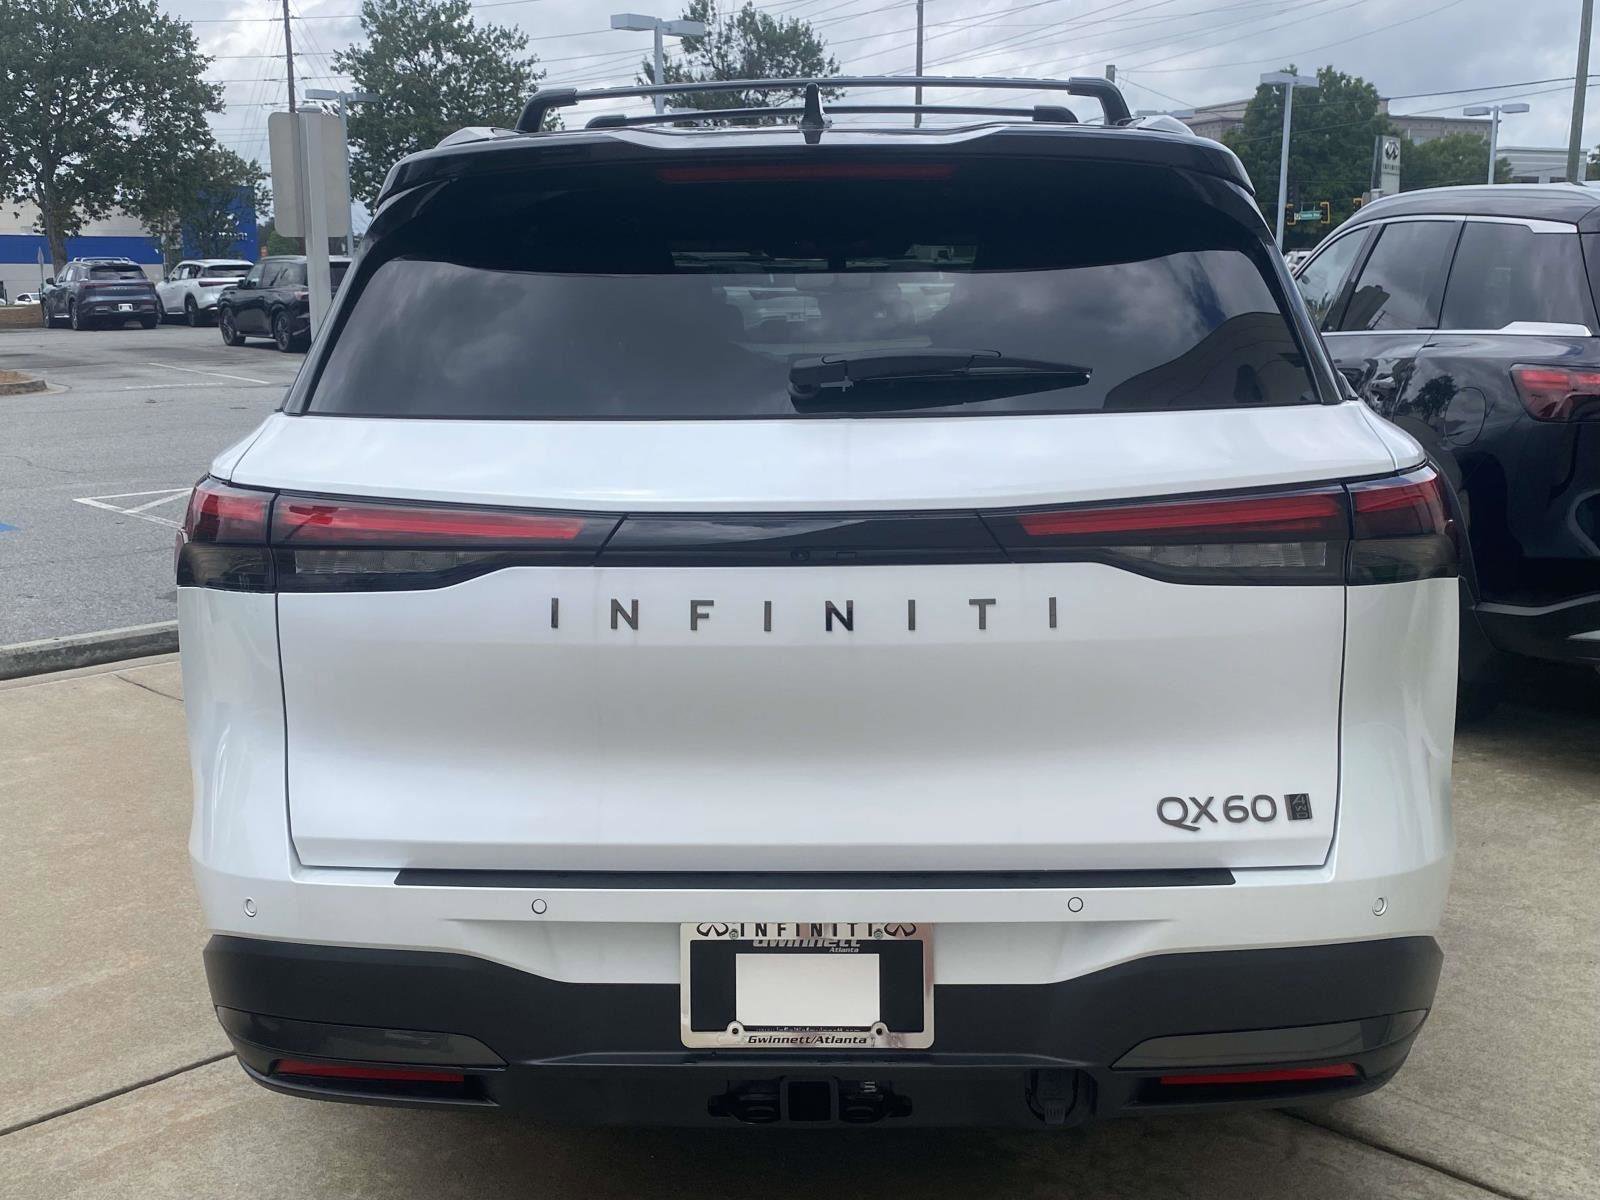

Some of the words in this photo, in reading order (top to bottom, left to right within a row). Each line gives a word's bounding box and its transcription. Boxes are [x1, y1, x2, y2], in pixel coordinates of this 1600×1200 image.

[550, 597, 1057, 632] INFINITI
[1157, 794, 1278, 832] QX60
[740, 922, 873, 937] INFINITI
[748, 1035, 867, 1044] Gwinnett/Atlanta
